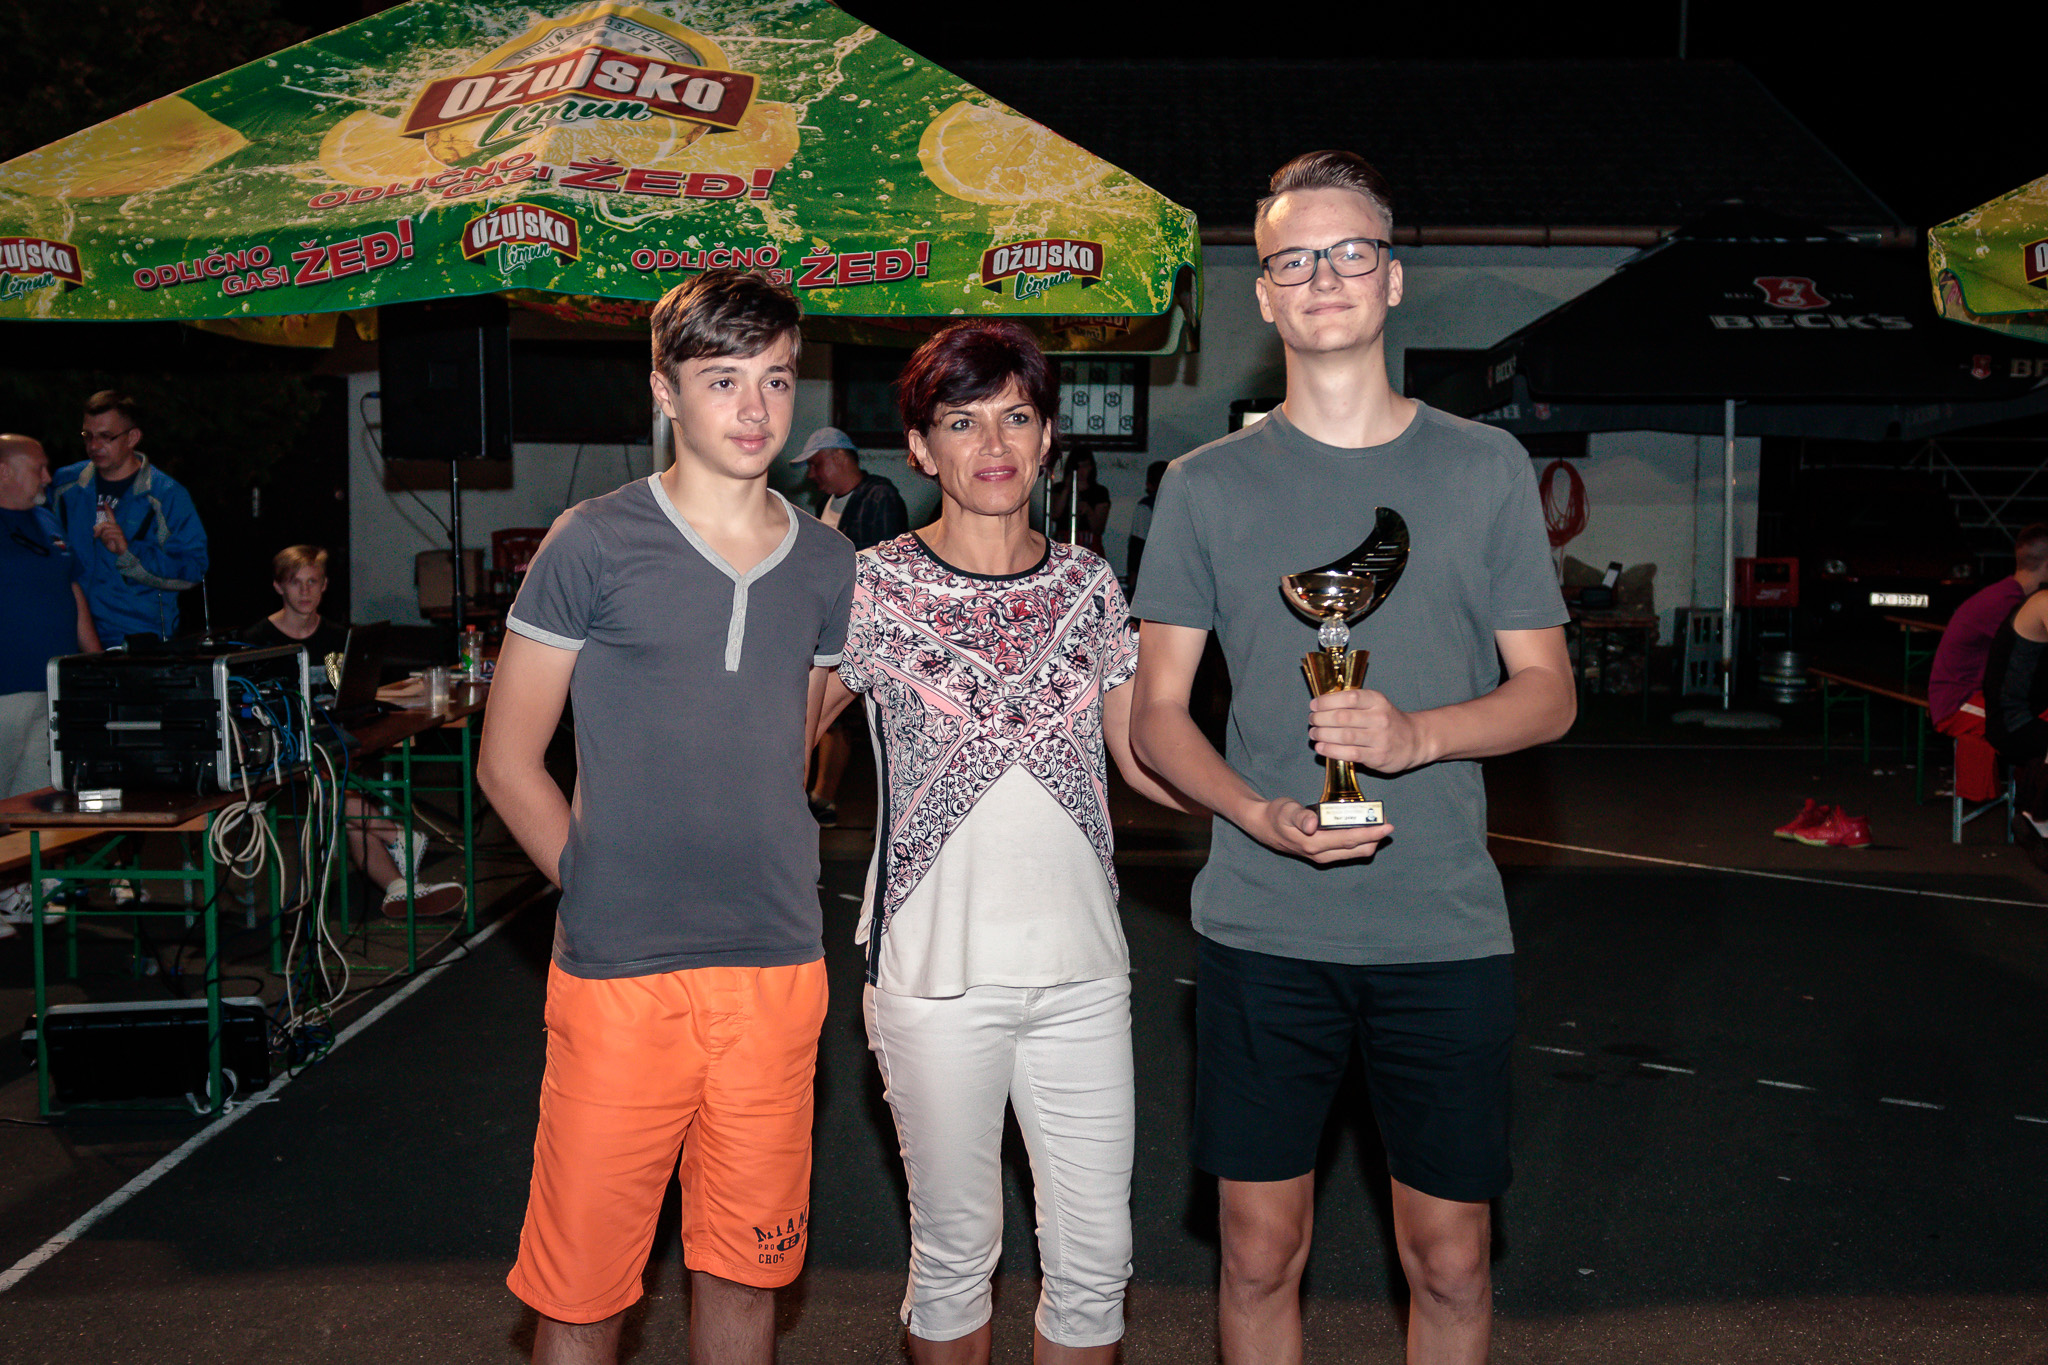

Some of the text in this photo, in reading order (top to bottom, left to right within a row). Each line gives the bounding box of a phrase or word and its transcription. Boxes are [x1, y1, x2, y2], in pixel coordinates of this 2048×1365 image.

[438, 48, 728, 120] Ožujsko
[475, 98, 653, 149] Limun
[308, 151, 537, 209] ODLIČNO
[441, 157, 776, 200] GASI ŽEĐ!
[472, 206, 570, 248] Ožujsko
[133, 246, 271, 290] ODLIČNO
[222, 219, 415, 296] GASI ŽEĐ!
[498, 241, 551, 274] Limun
[631, 242, 781, 270] ODLIČNO
[797, 242, 932, 288] ŽEĐ!
[992, 241, 1094, 275] Ožujsko
[1014, 270, 1074, 300] Limun
[1709, 313, 1913, 329] BECK'S
[758, 1243, 775, 1251] PRO
